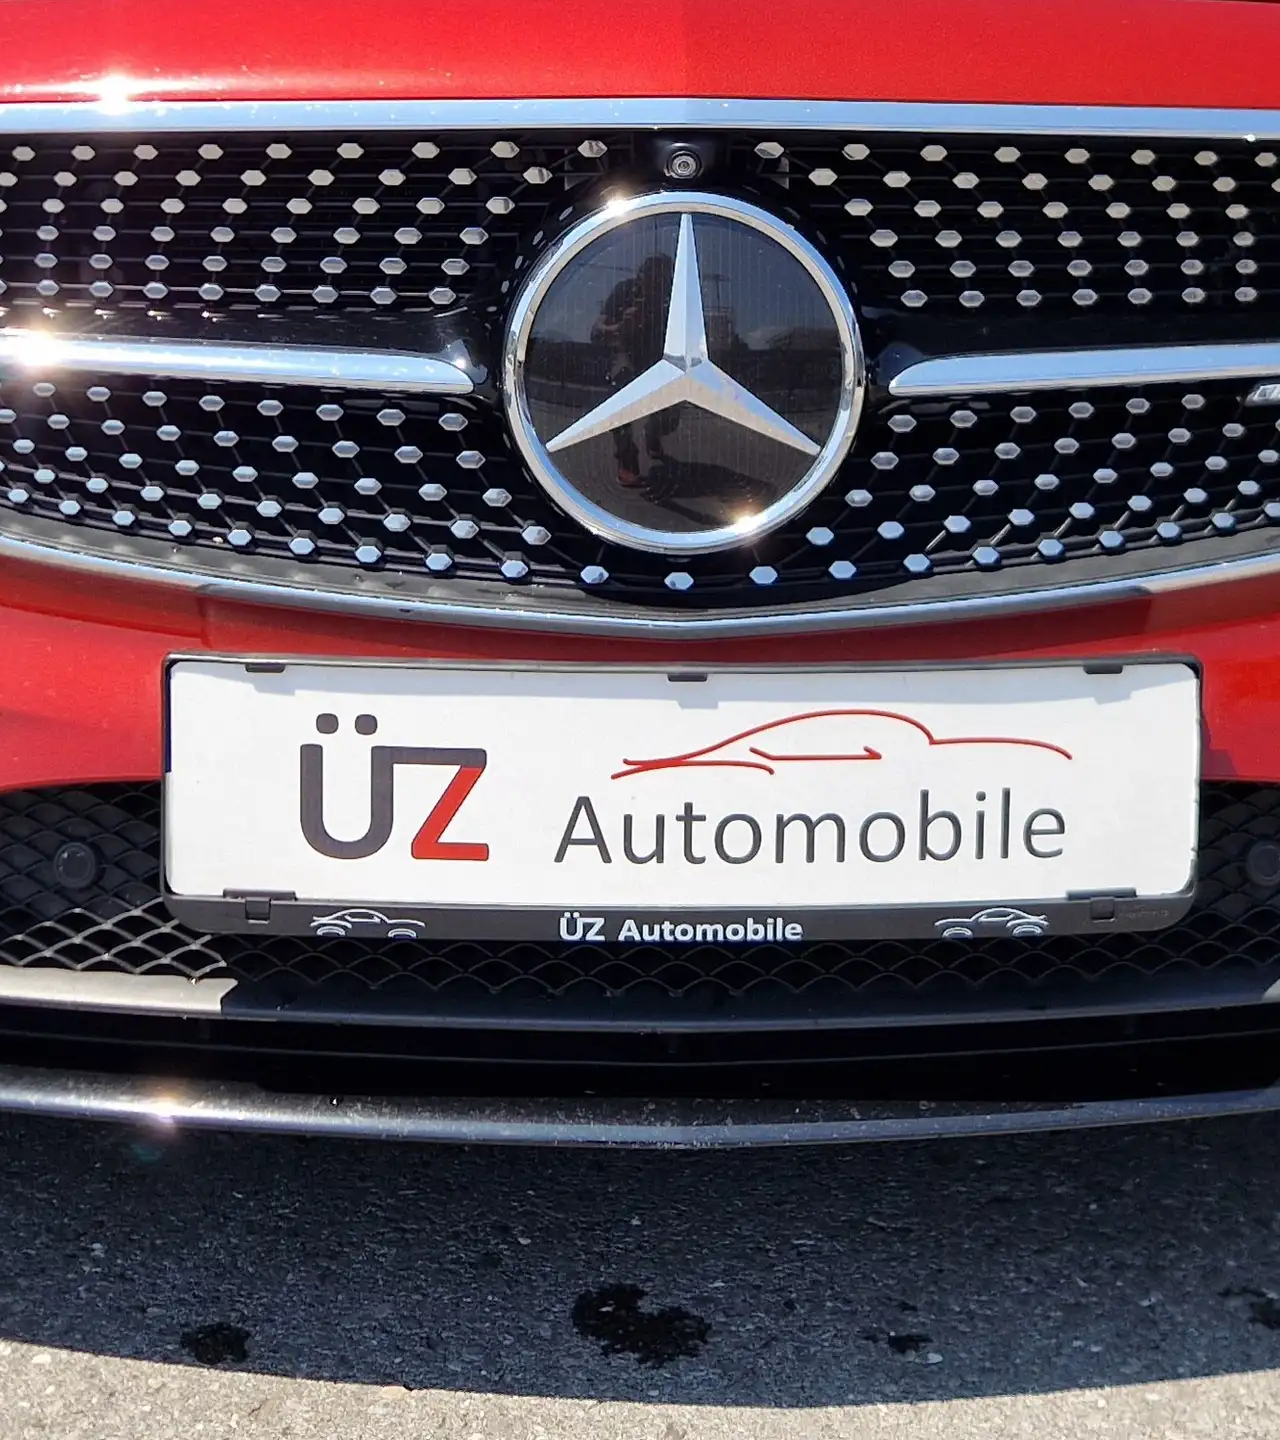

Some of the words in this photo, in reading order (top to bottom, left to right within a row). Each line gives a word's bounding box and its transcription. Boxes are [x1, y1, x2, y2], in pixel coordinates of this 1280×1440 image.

[299, 712, 490, 862] ÜZ
[553, 787, 1066, 865] Automobile
[559, 911, 606, 942] ÜZ
[618, 916, 804, 943] Automobile
